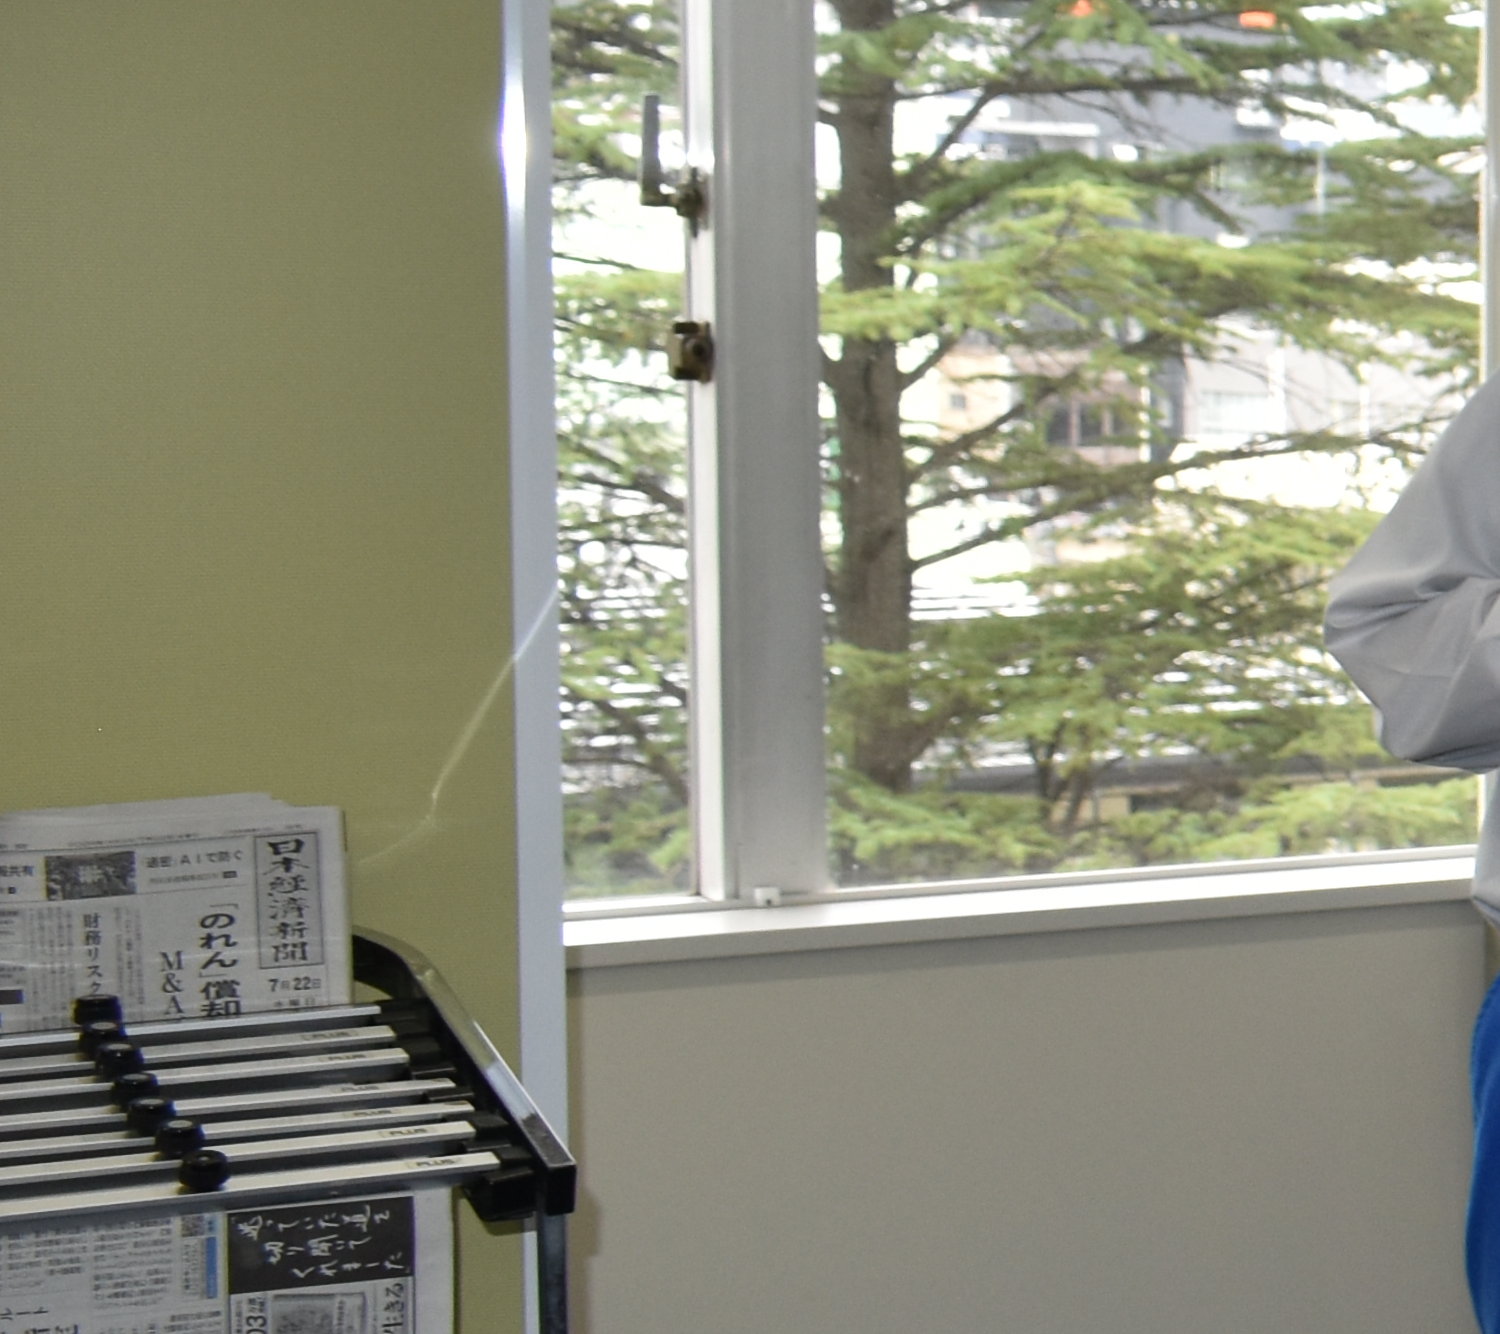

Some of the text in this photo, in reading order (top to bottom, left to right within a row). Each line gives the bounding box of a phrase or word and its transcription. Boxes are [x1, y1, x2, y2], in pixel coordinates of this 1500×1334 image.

[263, 838, 310, 963] 日本経済新聞
[159, 950, 185, 1014] M&A
